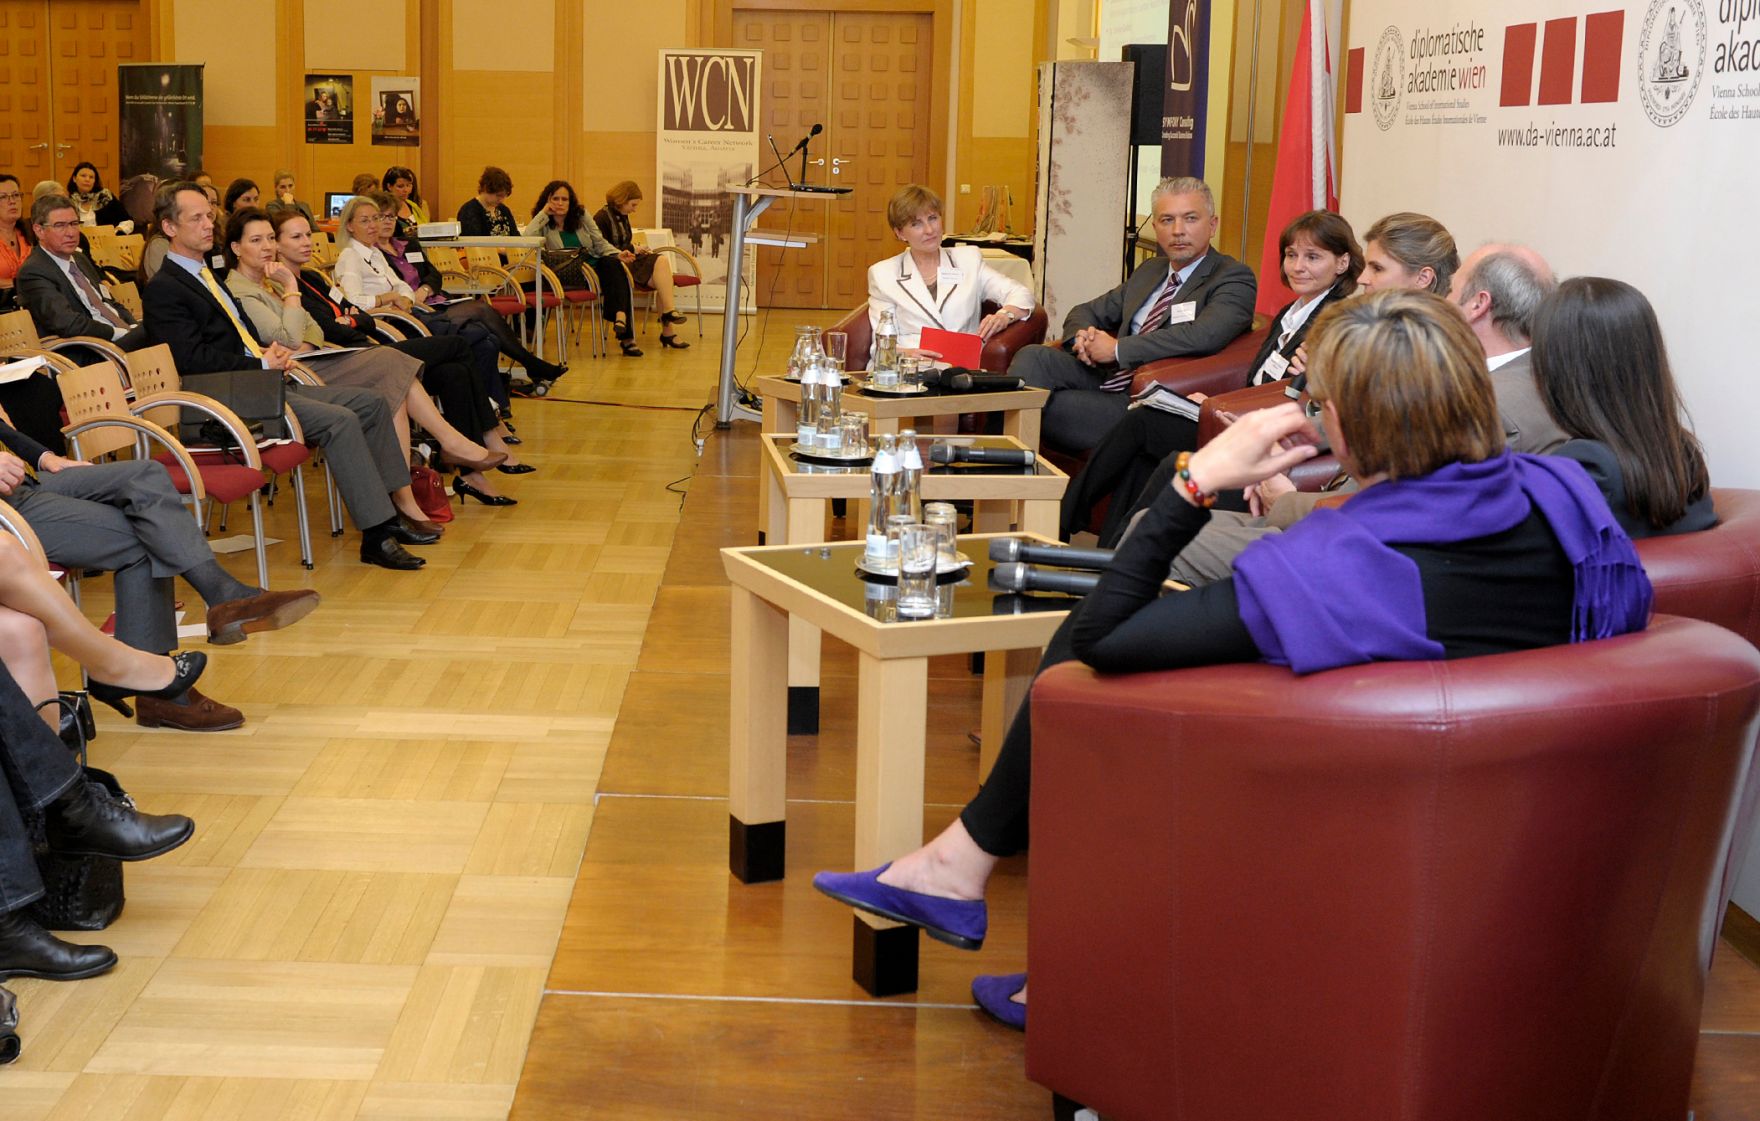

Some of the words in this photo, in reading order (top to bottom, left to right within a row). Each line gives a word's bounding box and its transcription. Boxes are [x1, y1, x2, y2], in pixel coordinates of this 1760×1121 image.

[1410, 20, 1484, 67] diplomatische
[1407, 59, 1457, 94] akademie
[1458, 57, 1486, 90] wien
[667, 56, 754, 131] WCN
[1712, 85, 1736, 98] Vienna
[1728, 105, 1740, 119] des
[1498, 121, 1617, 147] www.da-vienna.ac.at
